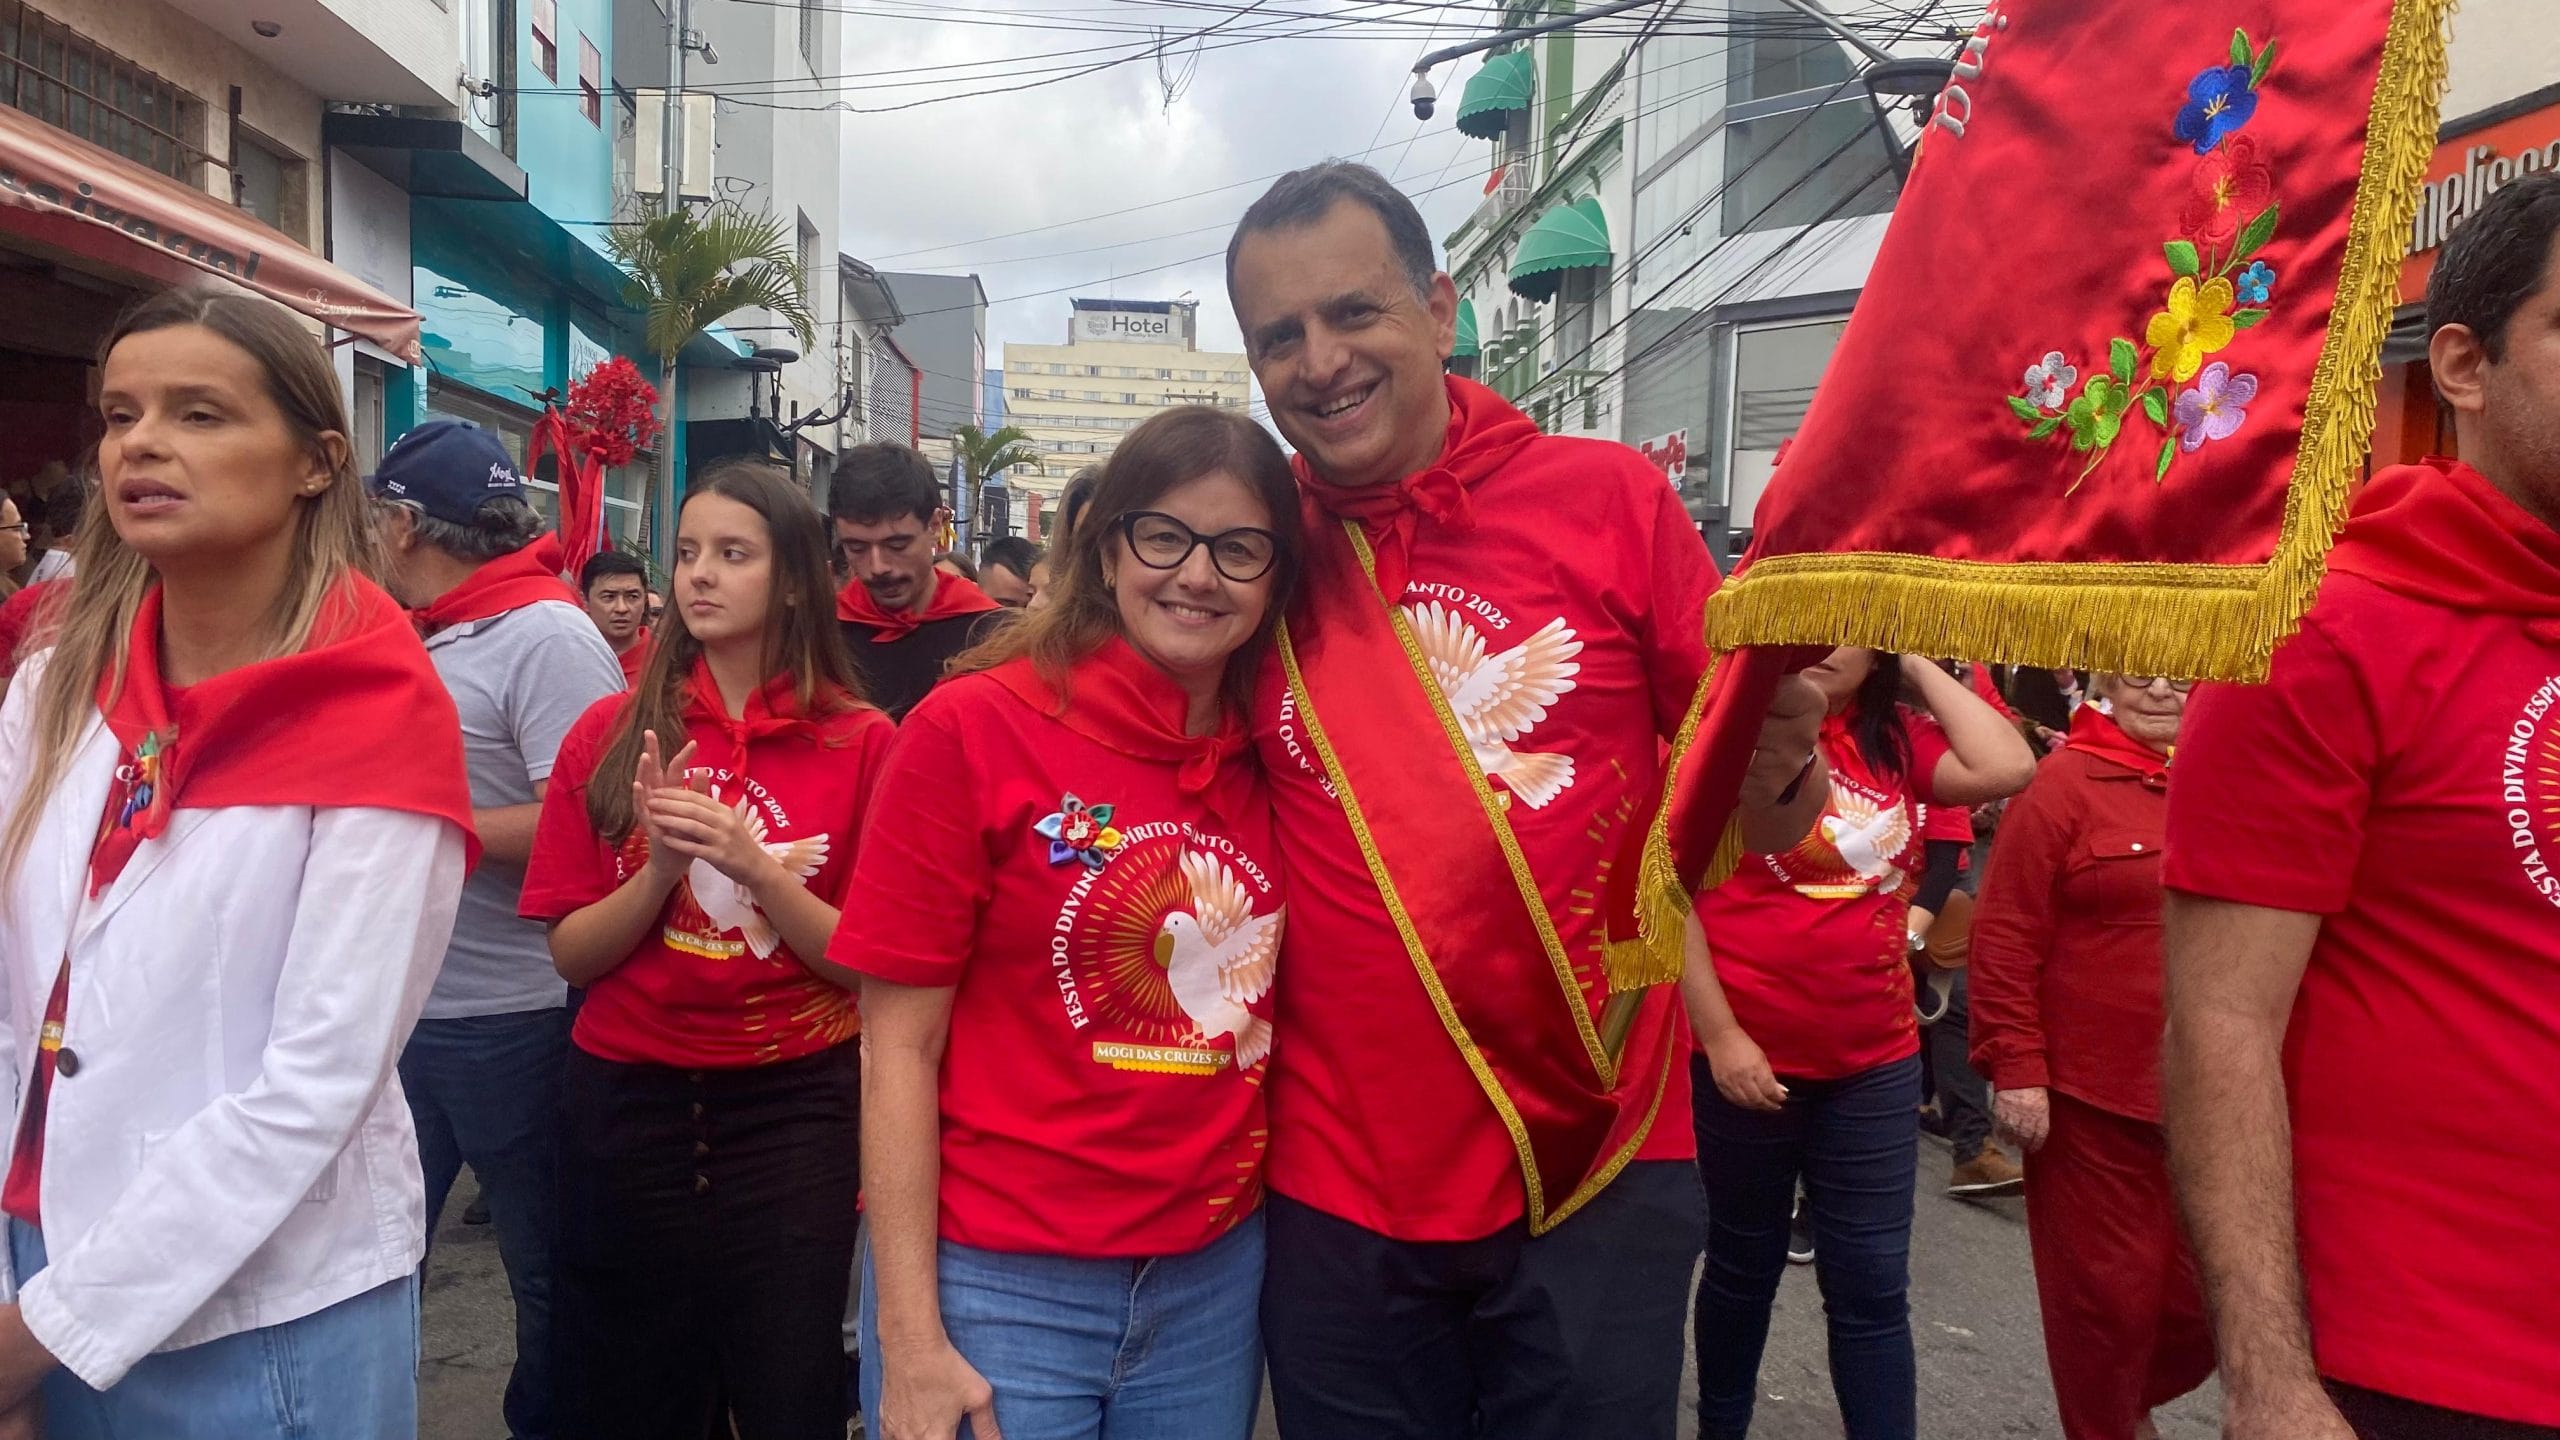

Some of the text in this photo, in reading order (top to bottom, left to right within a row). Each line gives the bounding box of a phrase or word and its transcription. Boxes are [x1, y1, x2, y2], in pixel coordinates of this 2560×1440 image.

[1112, 315, 1168, 334] Hotel
[1404, 580, 1511, 631] ANTO 2025
[1279, 685, 1295, 721] DIV
[1279, 724, 1301, 758] DO
[1860, 785, 1889, 802] 2025
[2503, 676, 2560, 908] ESTA DO DIVINO ESPÍ
[763, 797, 791, 828] 2025
[1104, 821, 1179, 864] ESPÍRITO
[1234, 850, 1272, 893] 2025
[1055, 865, 1105, 934] DIVINO
[729, 943, 742, 952] SP
[1051, 934, 1069, 967] DO
[1058, 966, 1089, 1030] FESTA
[1097, 1046, 1134, 1060] MOGI
[1136, 1048, 1162, 1062] DAS
[1164, 1051, 1212, 1065] CRUZES
[1219, 1054, 1231, 1065] SP
